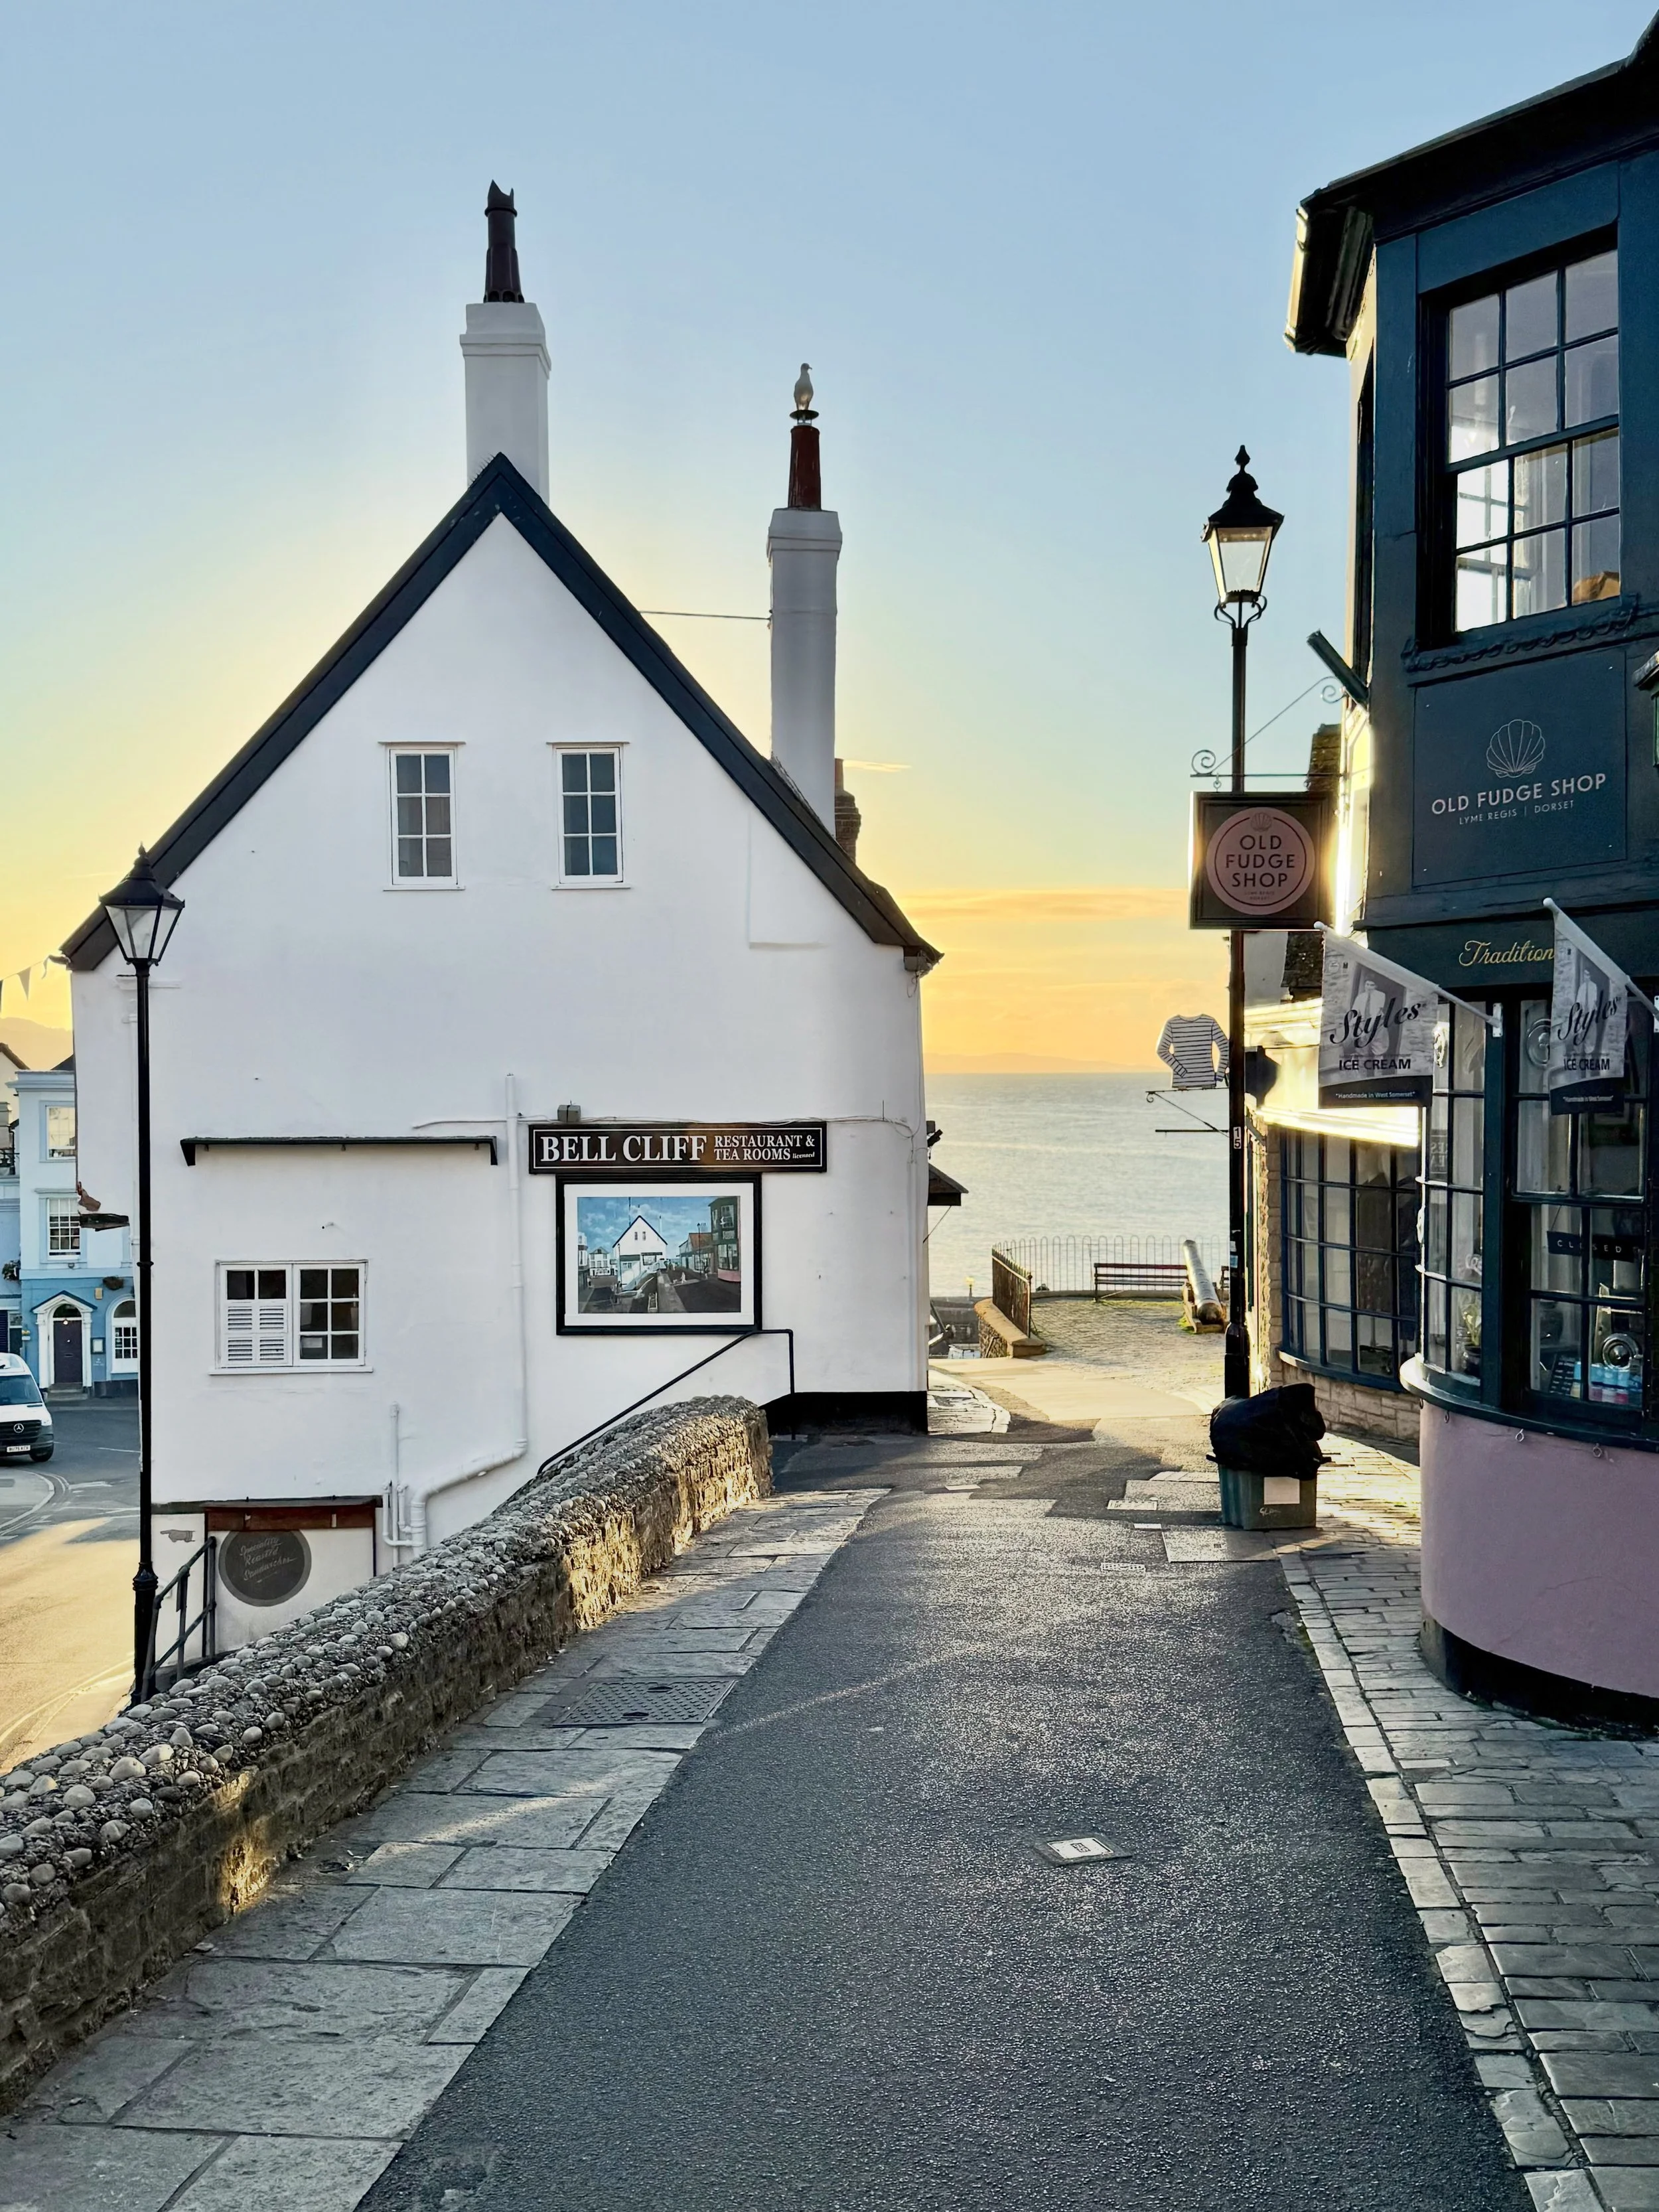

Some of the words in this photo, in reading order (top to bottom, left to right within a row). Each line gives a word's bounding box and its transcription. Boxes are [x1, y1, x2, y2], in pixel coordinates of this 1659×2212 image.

[1431, 795, 1469, 815] OLD
[1477, 782, 1543, 807] FUDGE
[1551, 773, 1607, 796] SHOP
[1459, 814, 1483, 825] LYME
[1488, 808, 1518, 820] REGIS
[1534, 800, 1575, 814] DORSET
[1240, 835, 1282, 850] OLD
[1225, 854, 1295, 869] FUDGE
[1232, 873, 1288, 887] SHOP
[1339, 1059, 1360, 1070] ICE
[1364, 1059, 1411, 1070] CREAM
[1563, 1059, 1577, 1070] ICE
[1579, 1058, 1610, 1070] CREAM
[714, 1135, 802, 1147] RESTAURANT
[805, 1135, 816, 1147] &
[540, 1136, 616, 1162] BELL
[622, 1135, 707, 1161] CLIFF
[713, 1148, 741, 1161] TEA
[743, 1147, 791, 1161] ROOMS
[1557, 1240, 1623, 1254] CLSED
